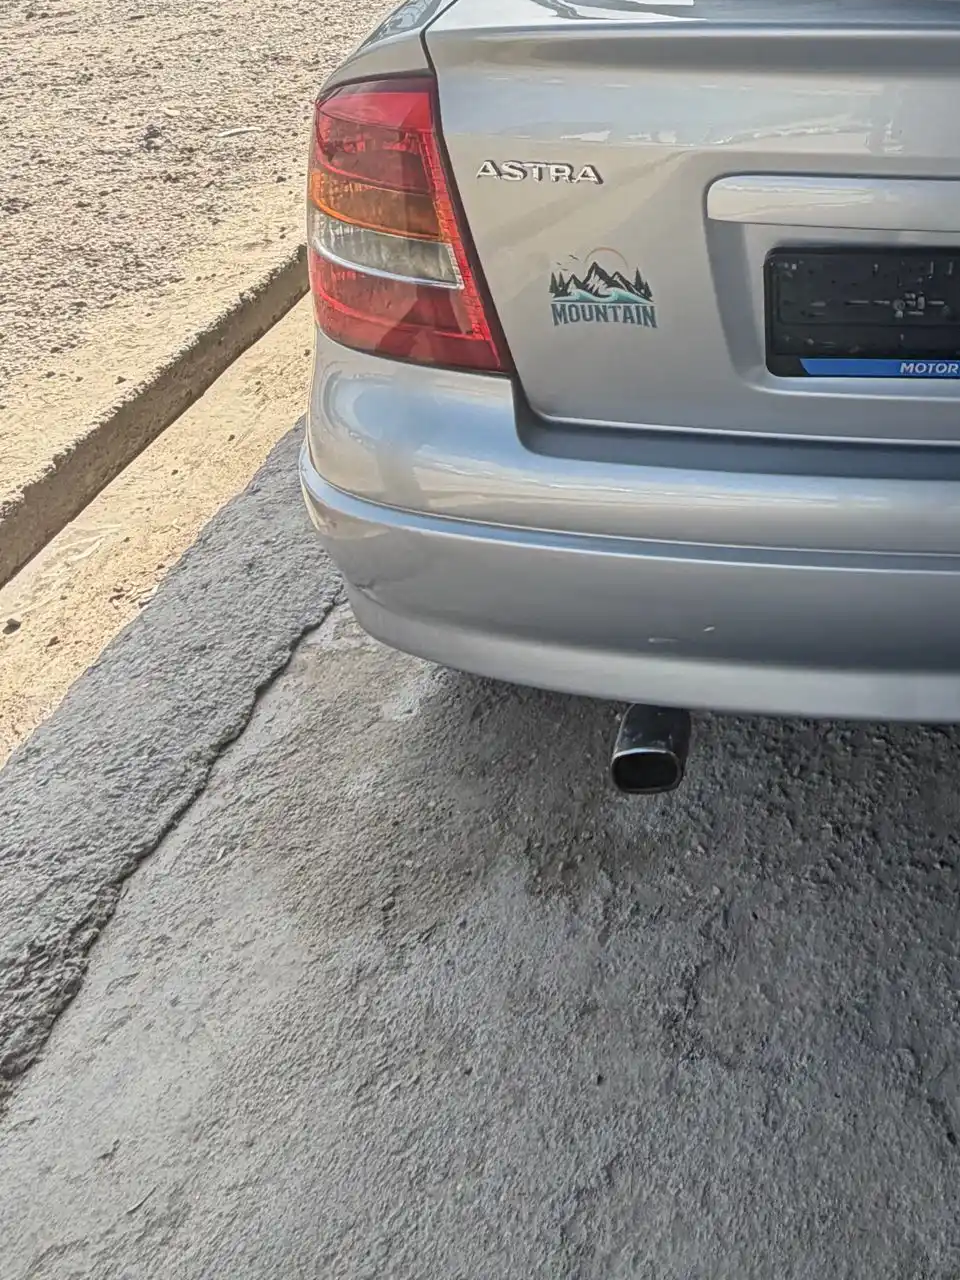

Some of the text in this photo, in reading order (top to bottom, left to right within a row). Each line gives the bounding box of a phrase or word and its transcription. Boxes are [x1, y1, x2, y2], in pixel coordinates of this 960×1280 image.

[476, 159, 604, 185] ASTRA
[551, 303, 658, 328] MOUNTAIN
[900, 362, 959, 375] MOTOR
